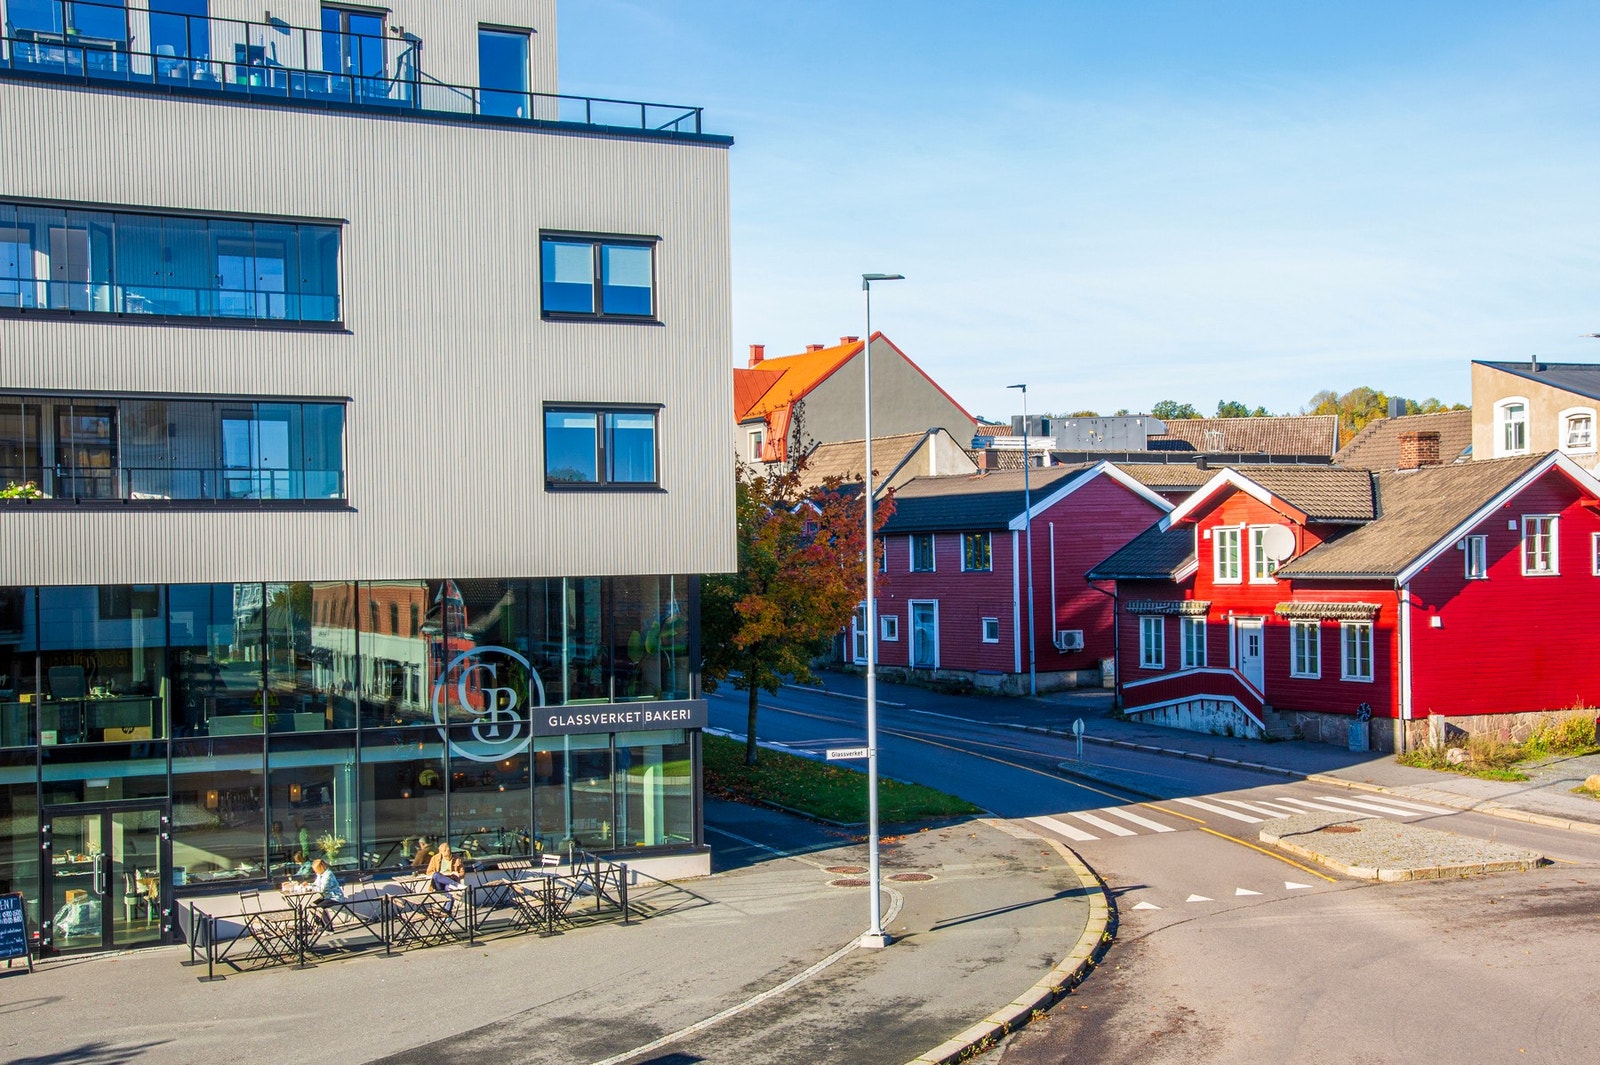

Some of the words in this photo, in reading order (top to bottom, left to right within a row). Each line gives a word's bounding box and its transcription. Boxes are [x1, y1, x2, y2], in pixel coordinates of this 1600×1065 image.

[548, 711, 642, 727] GLASSVERKET
[645, 709, 691, 722] BAKERI
[831, 750, 863, 758] Glassverket
